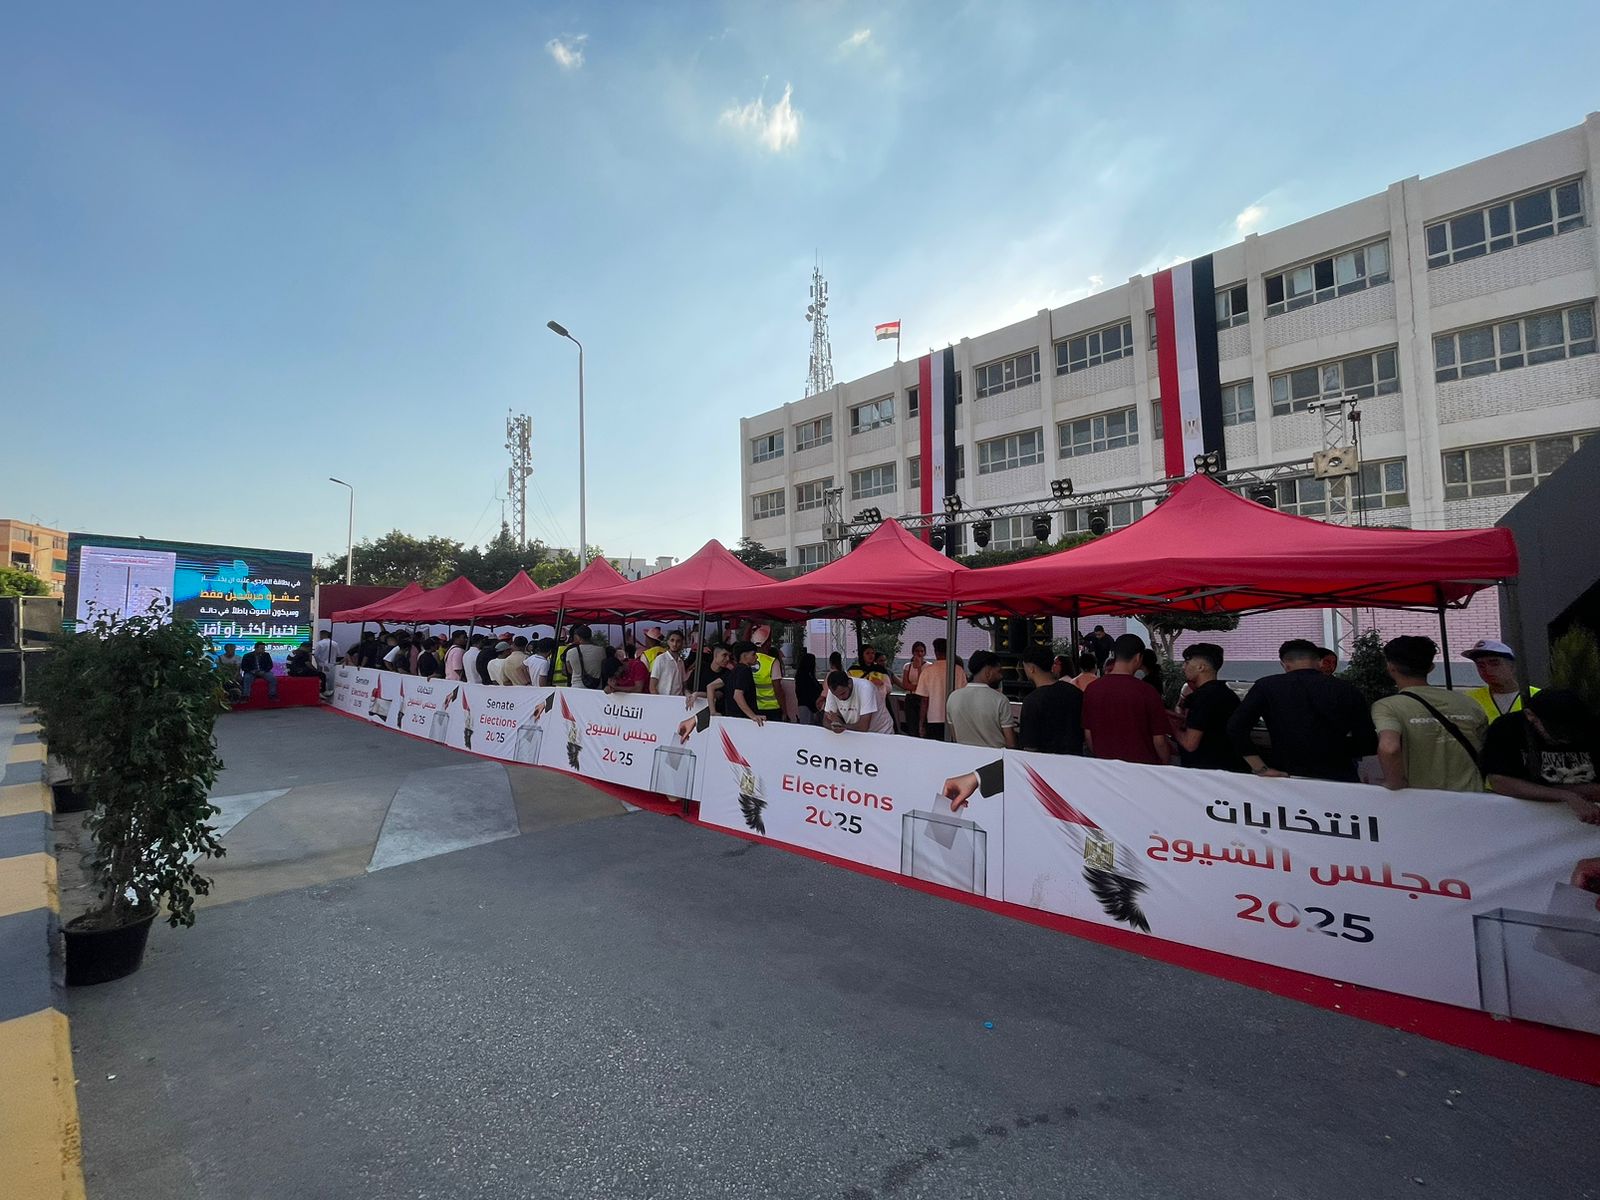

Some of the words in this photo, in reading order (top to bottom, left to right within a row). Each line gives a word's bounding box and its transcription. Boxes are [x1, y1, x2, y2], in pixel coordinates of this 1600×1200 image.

[218, 608, 230, 616] في
[249, 608, 271, 617] الصوت
[272, 609, 299, 617] وسيكون
[203, 621, 222, 637] أقل
[224, 622, 237, 638] أو
[268, 624, 298, 638] اختيار
[486, 698, 515, 711] Senate
[603, 703, 644, 720] انتخابات
[480, 714, 517, 728] Elections
[585, 721, 621, 737] الشيوخ
[623, 729, 657, 744] مجلس
[796, 748, 879, 777] Senate
[782, 774, 894, 811] Elections
[805, 805, 863, 834] 2025
[1205, 798, 1379, 842] انتخابات
[1146, 829, 1292, 873] الشيوخ
[1309, 859, 1472, 901] مجلس
[1235, 893, 1375, 943] 2025
